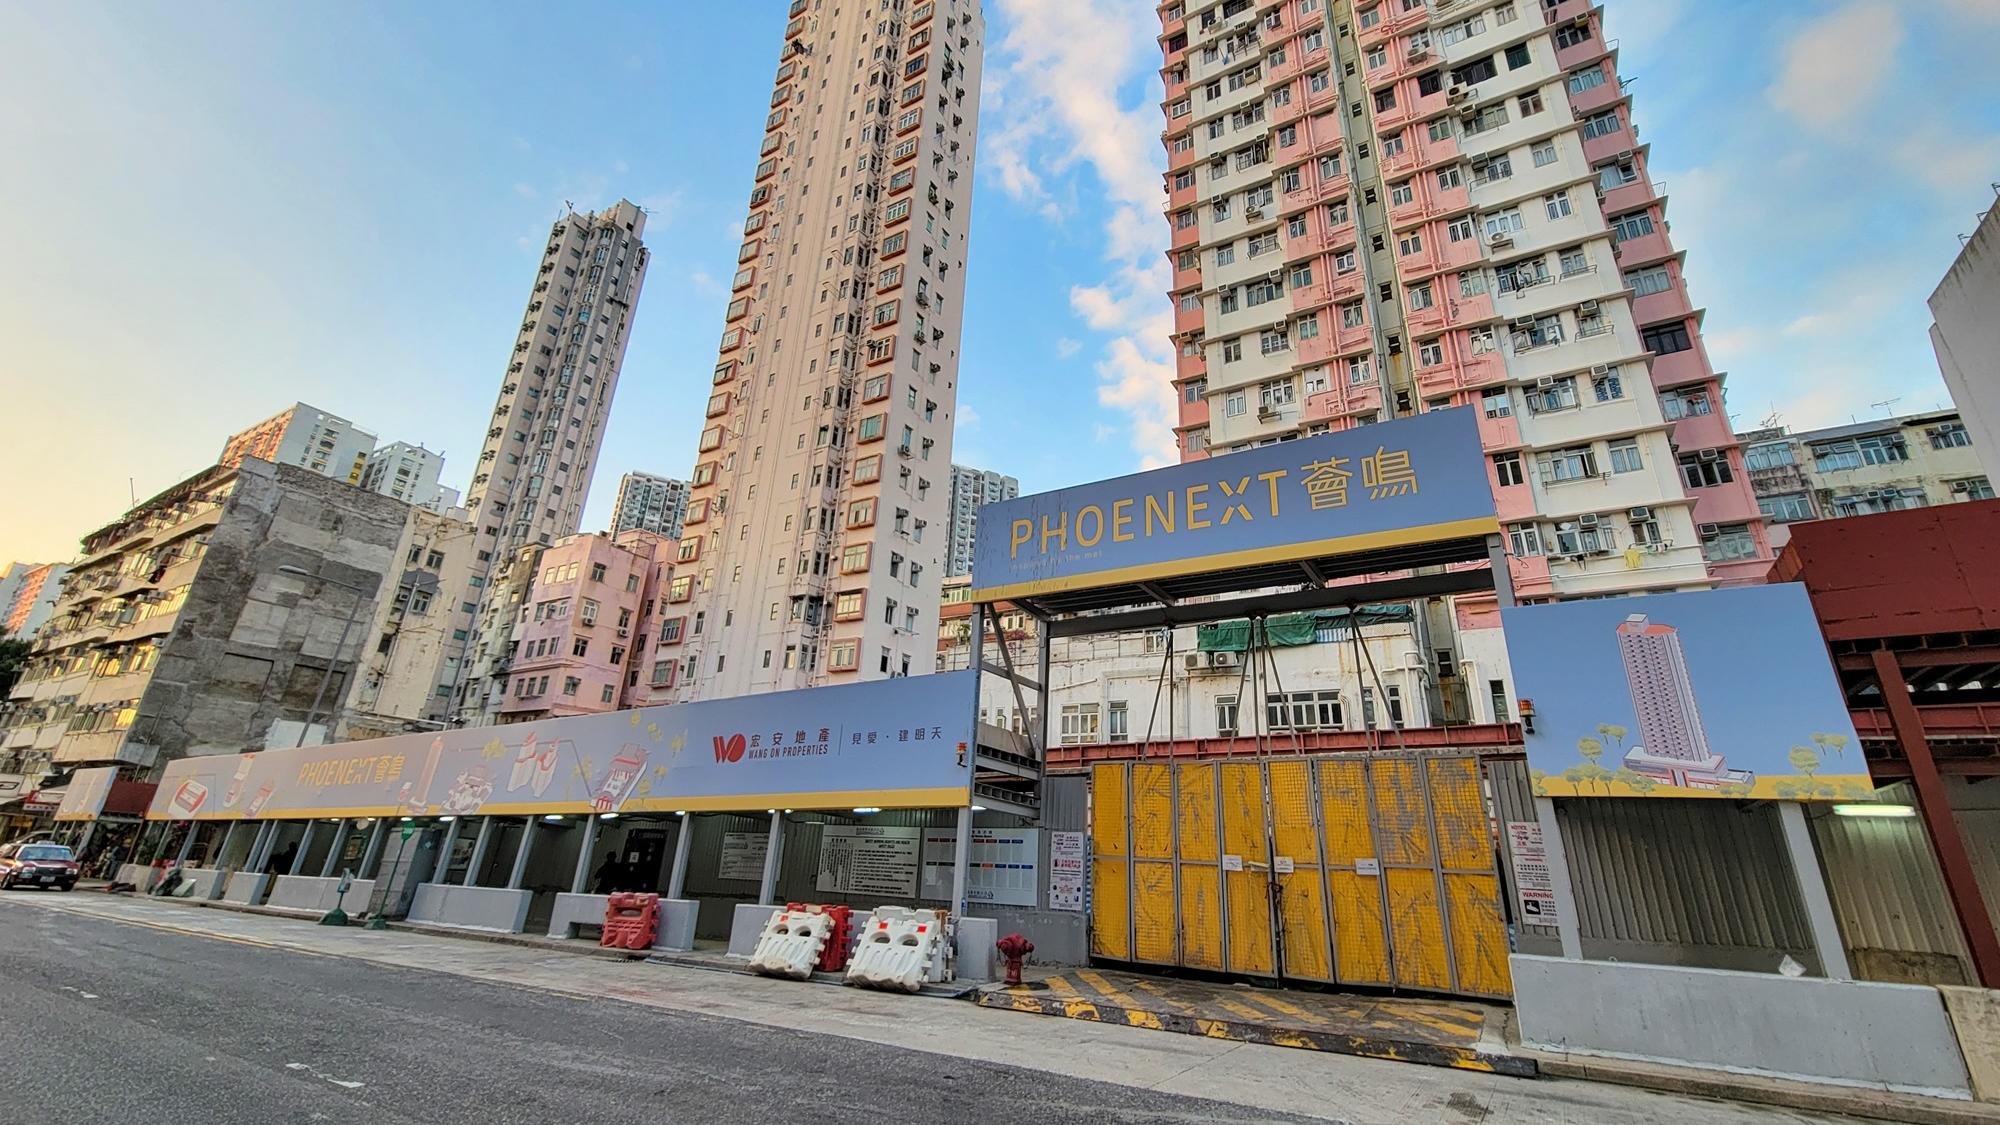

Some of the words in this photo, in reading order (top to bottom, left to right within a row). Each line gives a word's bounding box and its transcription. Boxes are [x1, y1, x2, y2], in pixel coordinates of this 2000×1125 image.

[1010, 469, 1288, 560] PHOENEXT
[1300, 446, 1418, 510] 薈鳴
[750, 728, 830, 748] 宏安地產
[749, 748, 768, 760] WANG
[770, 747, 780, 758] ON
[782, 744, 829, 757] PROPERTIES
[295, 757, 378, 787] PHOENEXT
